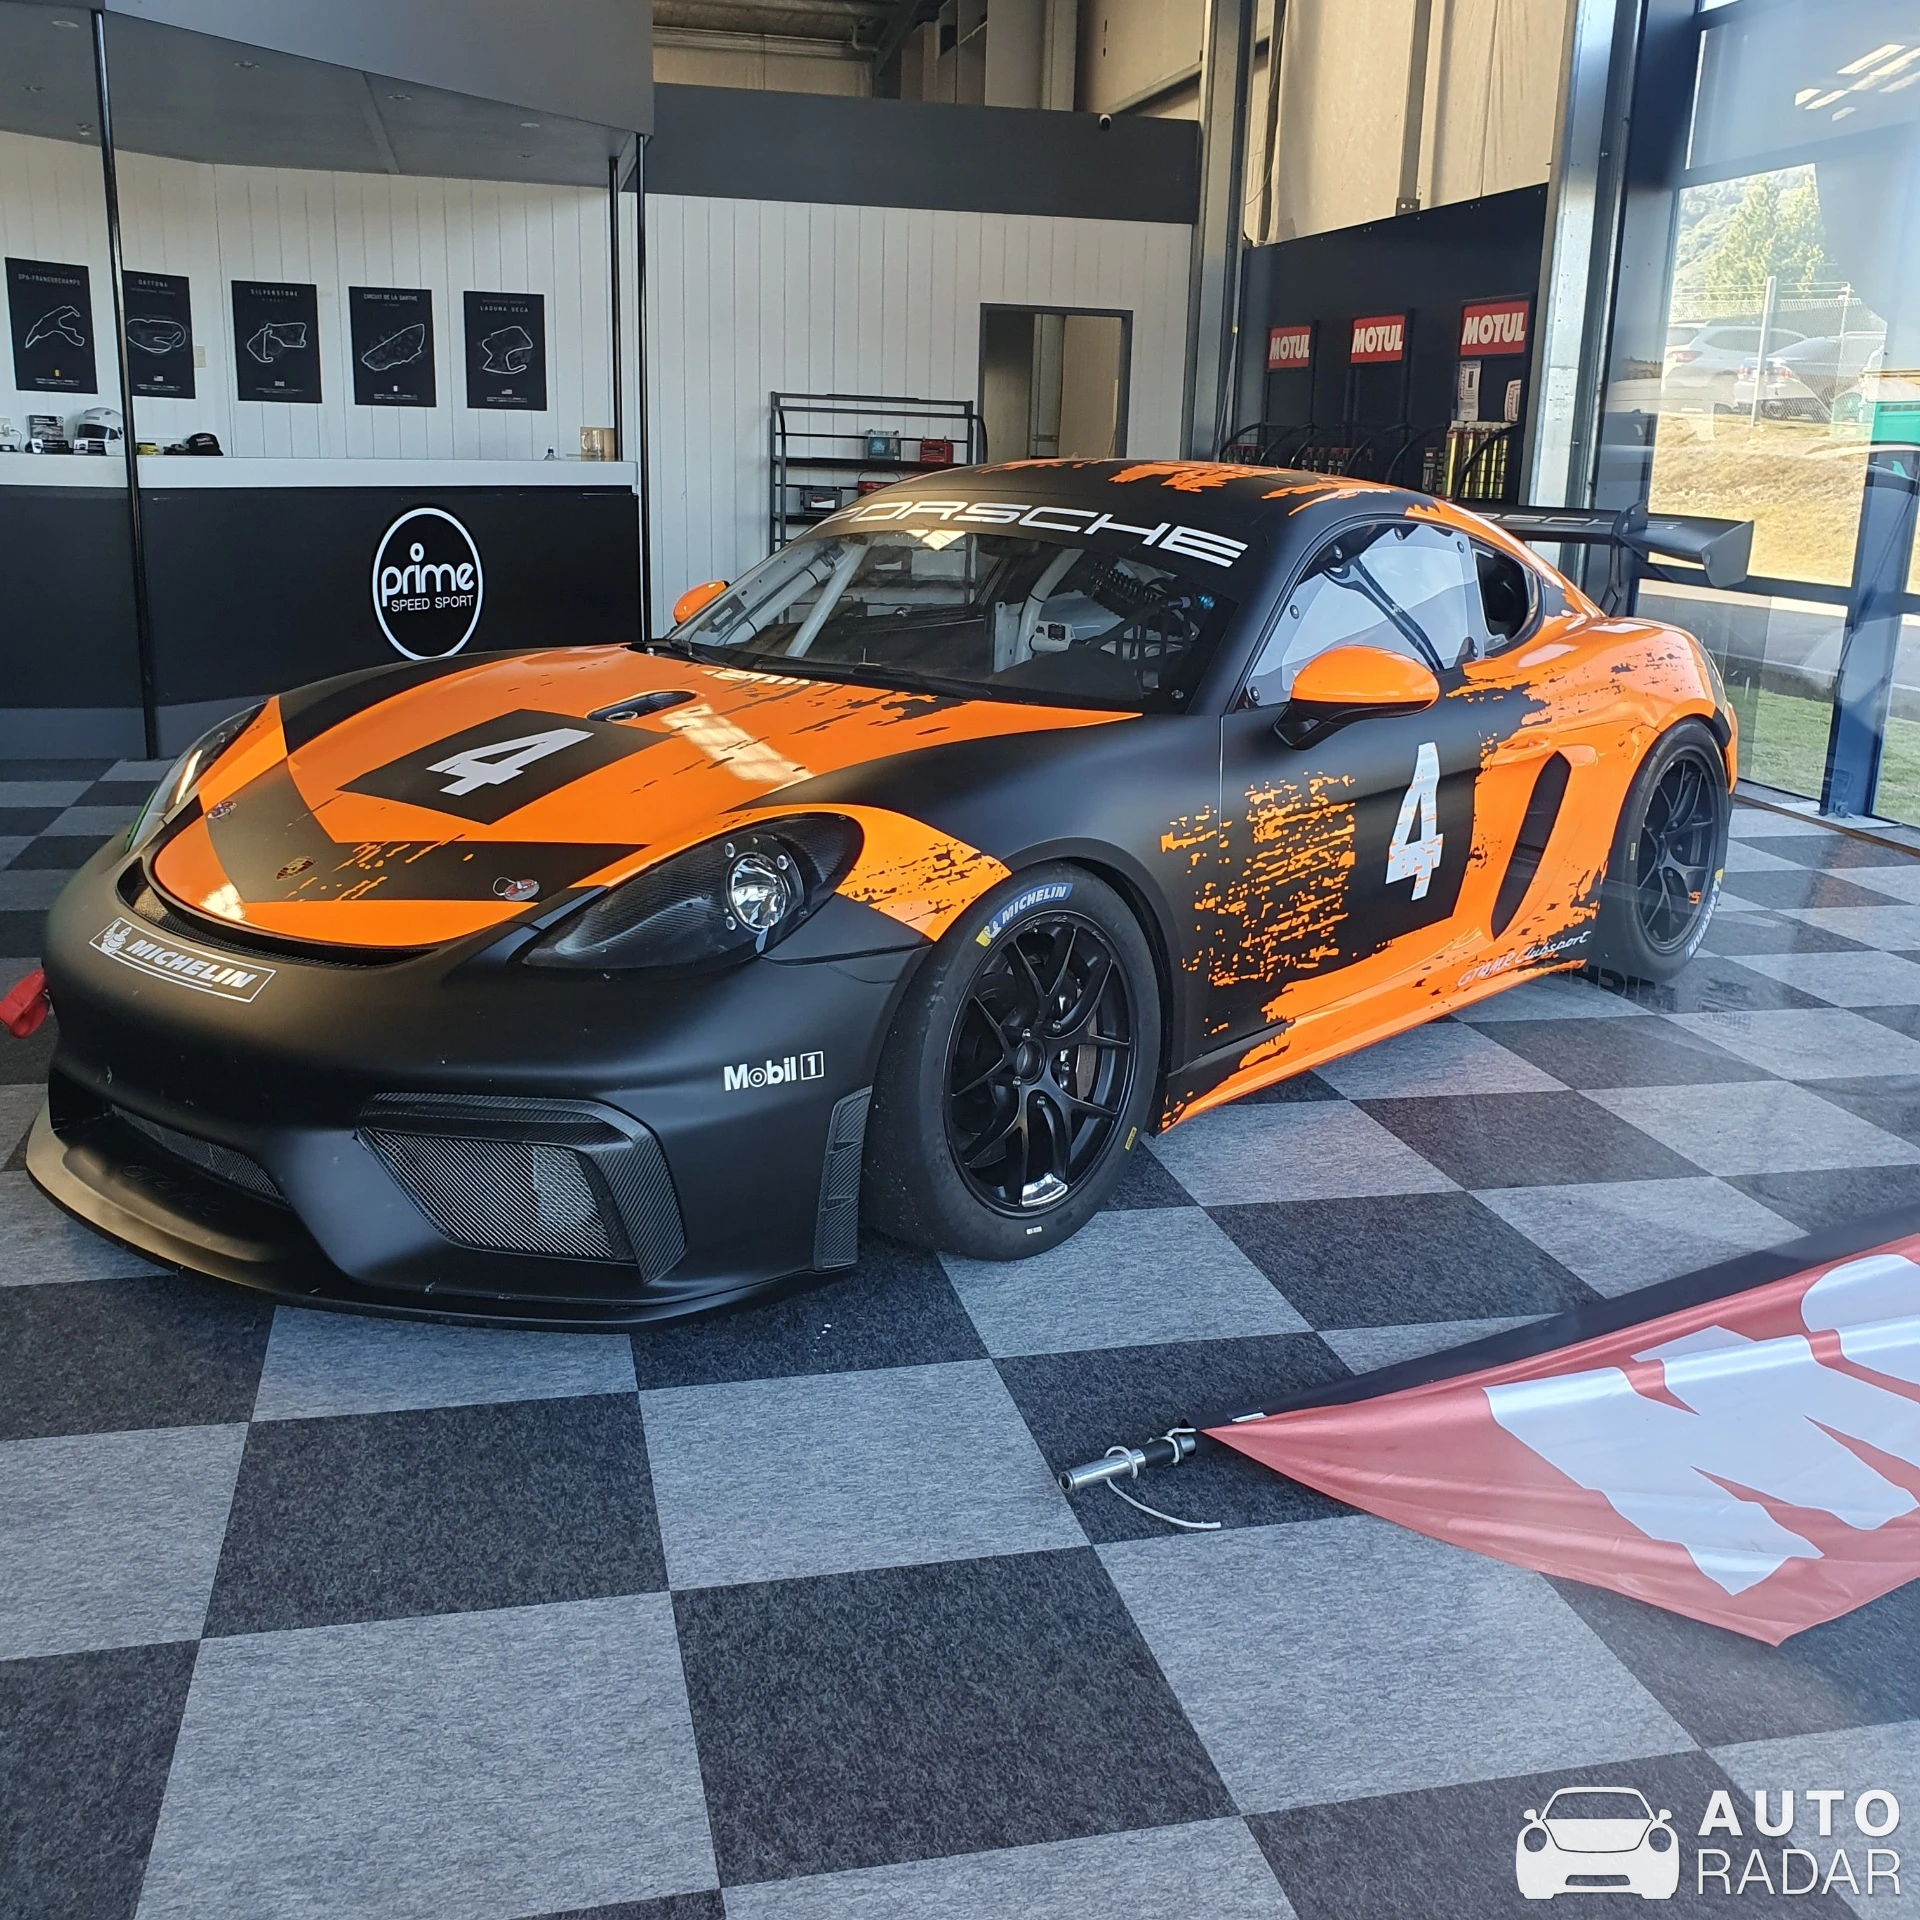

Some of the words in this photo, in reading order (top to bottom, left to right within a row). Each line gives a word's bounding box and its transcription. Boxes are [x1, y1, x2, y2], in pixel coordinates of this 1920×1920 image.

[1351, 324, 1403, 354] MOTUL
[1461, 312, 1526, 345] MOTUL
[1269, 334, 1309, 360] MOTUL
[381, 542, 475, 607] prime
[391, 597, 431, 612] SPEED
[434, 595, 474, 609] SPORT
[425, 727, 595, 796] 4
[1385, 742, 1443, 901] 4
[1002, 886, 1067, 924] MICHELIN
[125, 939, 258, 989] MICHELIN
[724, 1056, 797, 1091] Mobil
